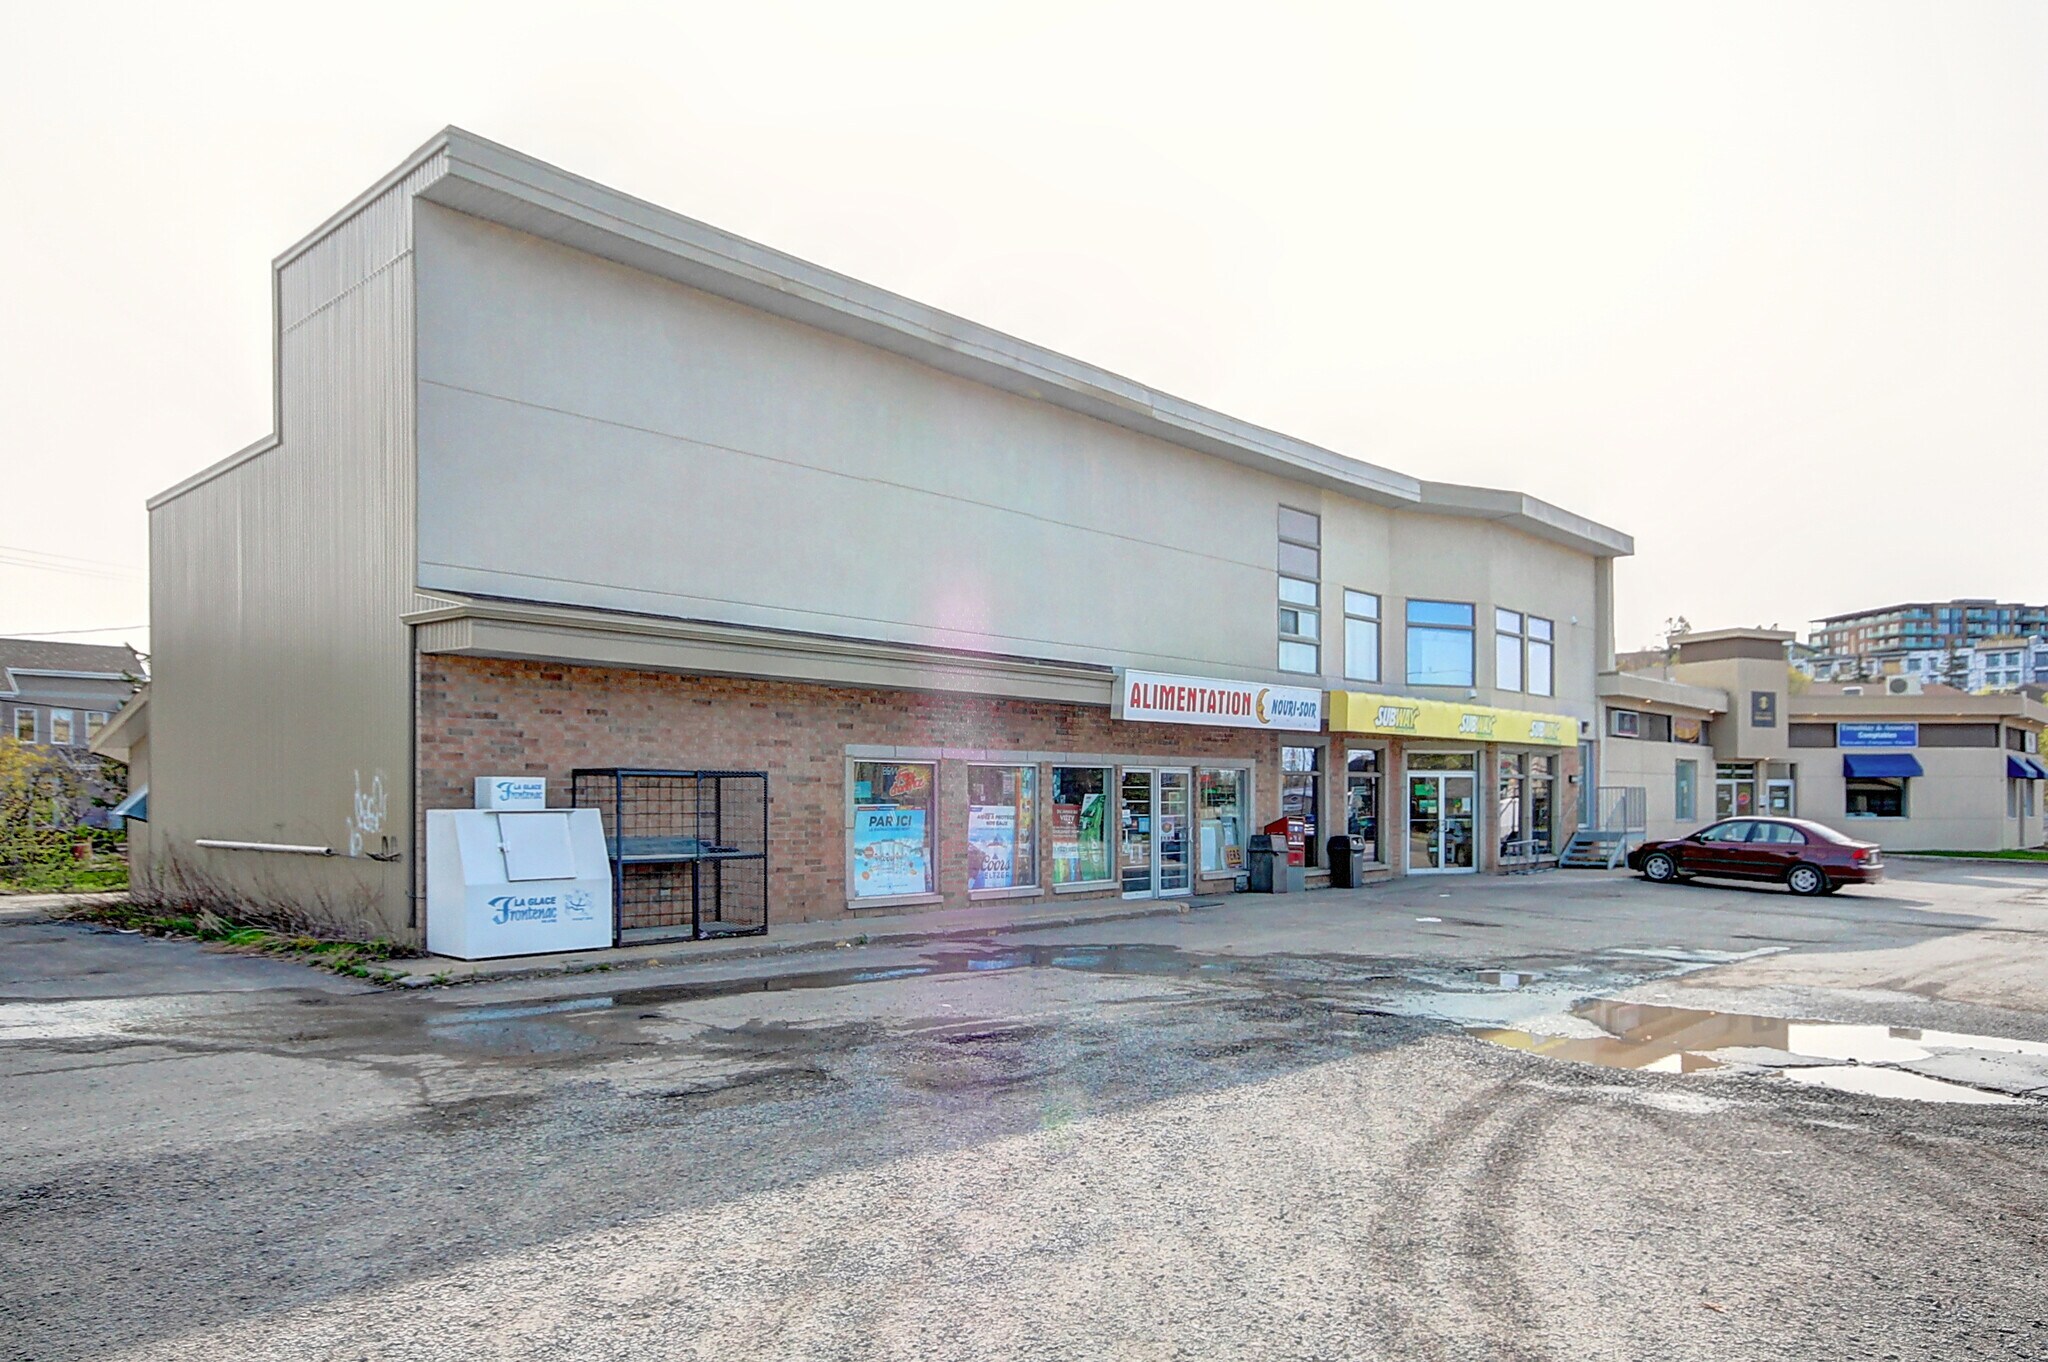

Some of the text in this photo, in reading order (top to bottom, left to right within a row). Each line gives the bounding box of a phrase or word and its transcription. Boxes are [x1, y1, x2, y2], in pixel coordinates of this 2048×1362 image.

[1130, 682, 1252, 716] ALIMENTATION
[1271, 699, 1317, 719] NOURI-SOIR
[1374, 705, 1420, 729] SUBWAY
[1459, 713, 1496, 735] SUBWAY
[1529, 720, 1560, 740] SUBWAY
[869, 815, 913, 827] PAR ICI
[982, 855, 1011, 871] Coors
[984, 872, 1010, 880] ELTZER
[488, 896, 557, 925] Frontenac
[514, 896, 556, 907] LA GLACE
